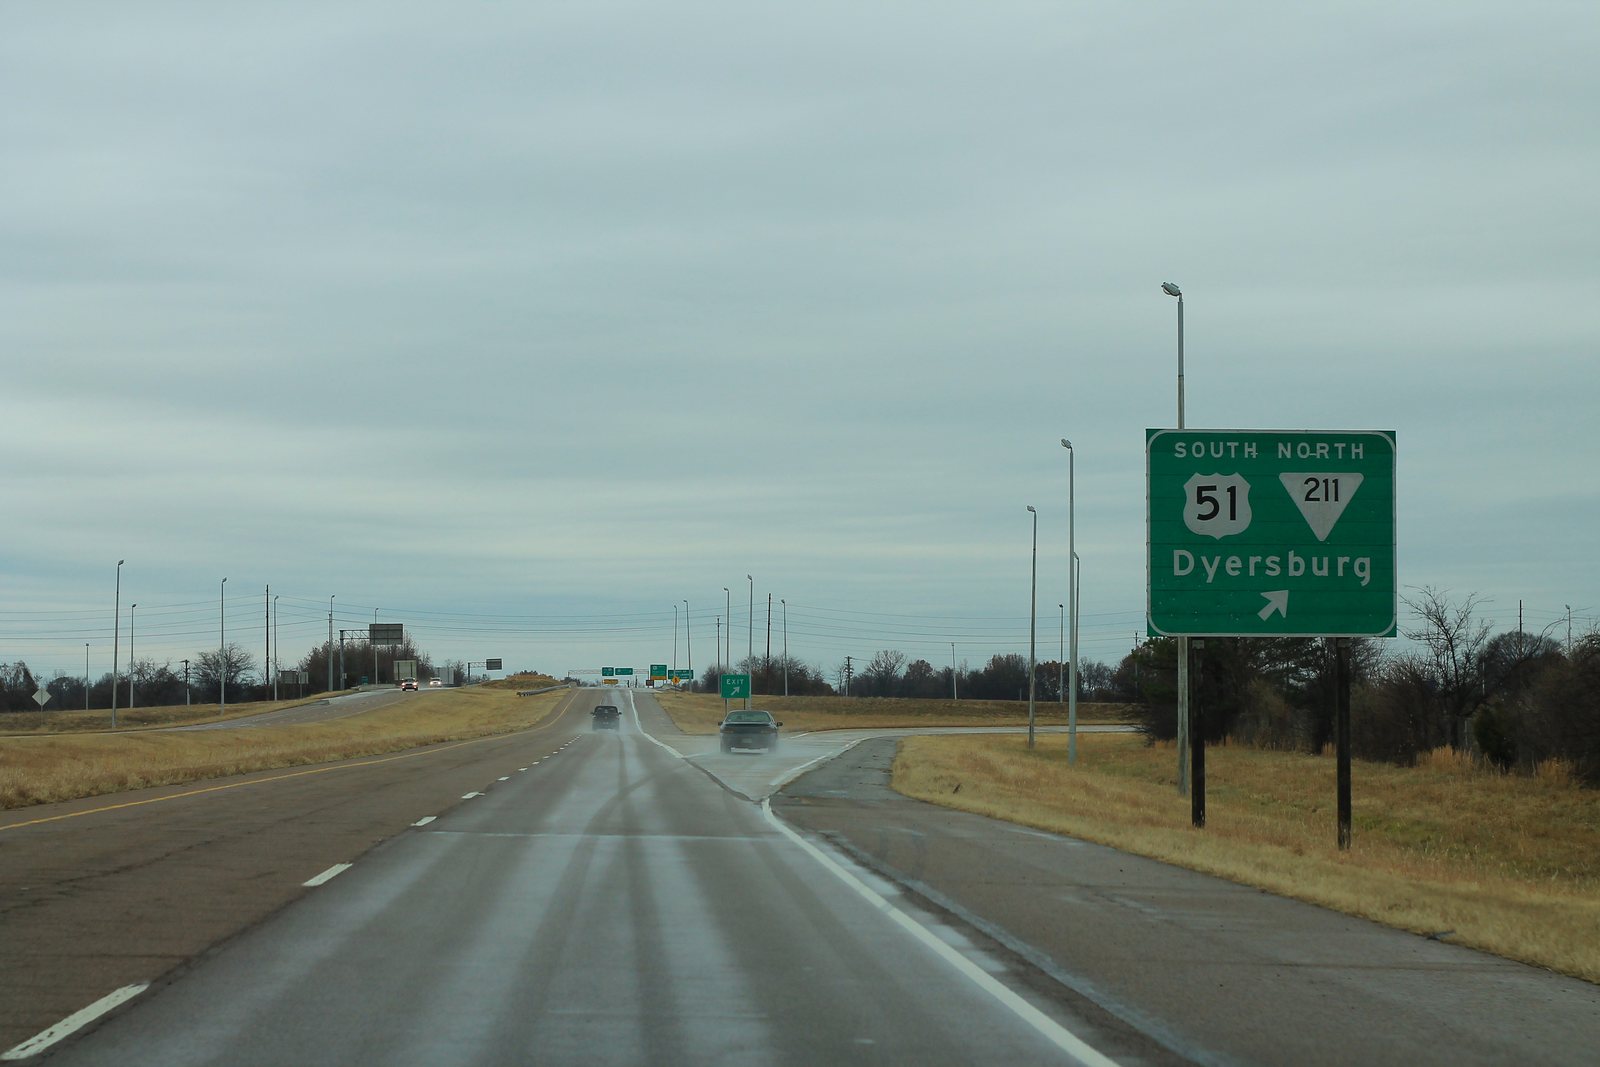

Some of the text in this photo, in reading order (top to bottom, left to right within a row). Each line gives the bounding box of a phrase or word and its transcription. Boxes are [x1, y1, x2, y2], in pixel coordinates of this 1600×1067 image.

[1174, 441, 1257, 459] SOUTH
[1278, 442, 1364, 459] NORTH
[1303, 477, 1339, 502] 211
[1196, 485, 1236, 520] 51
[1173, 549, 1371, 586] Dyersburg
